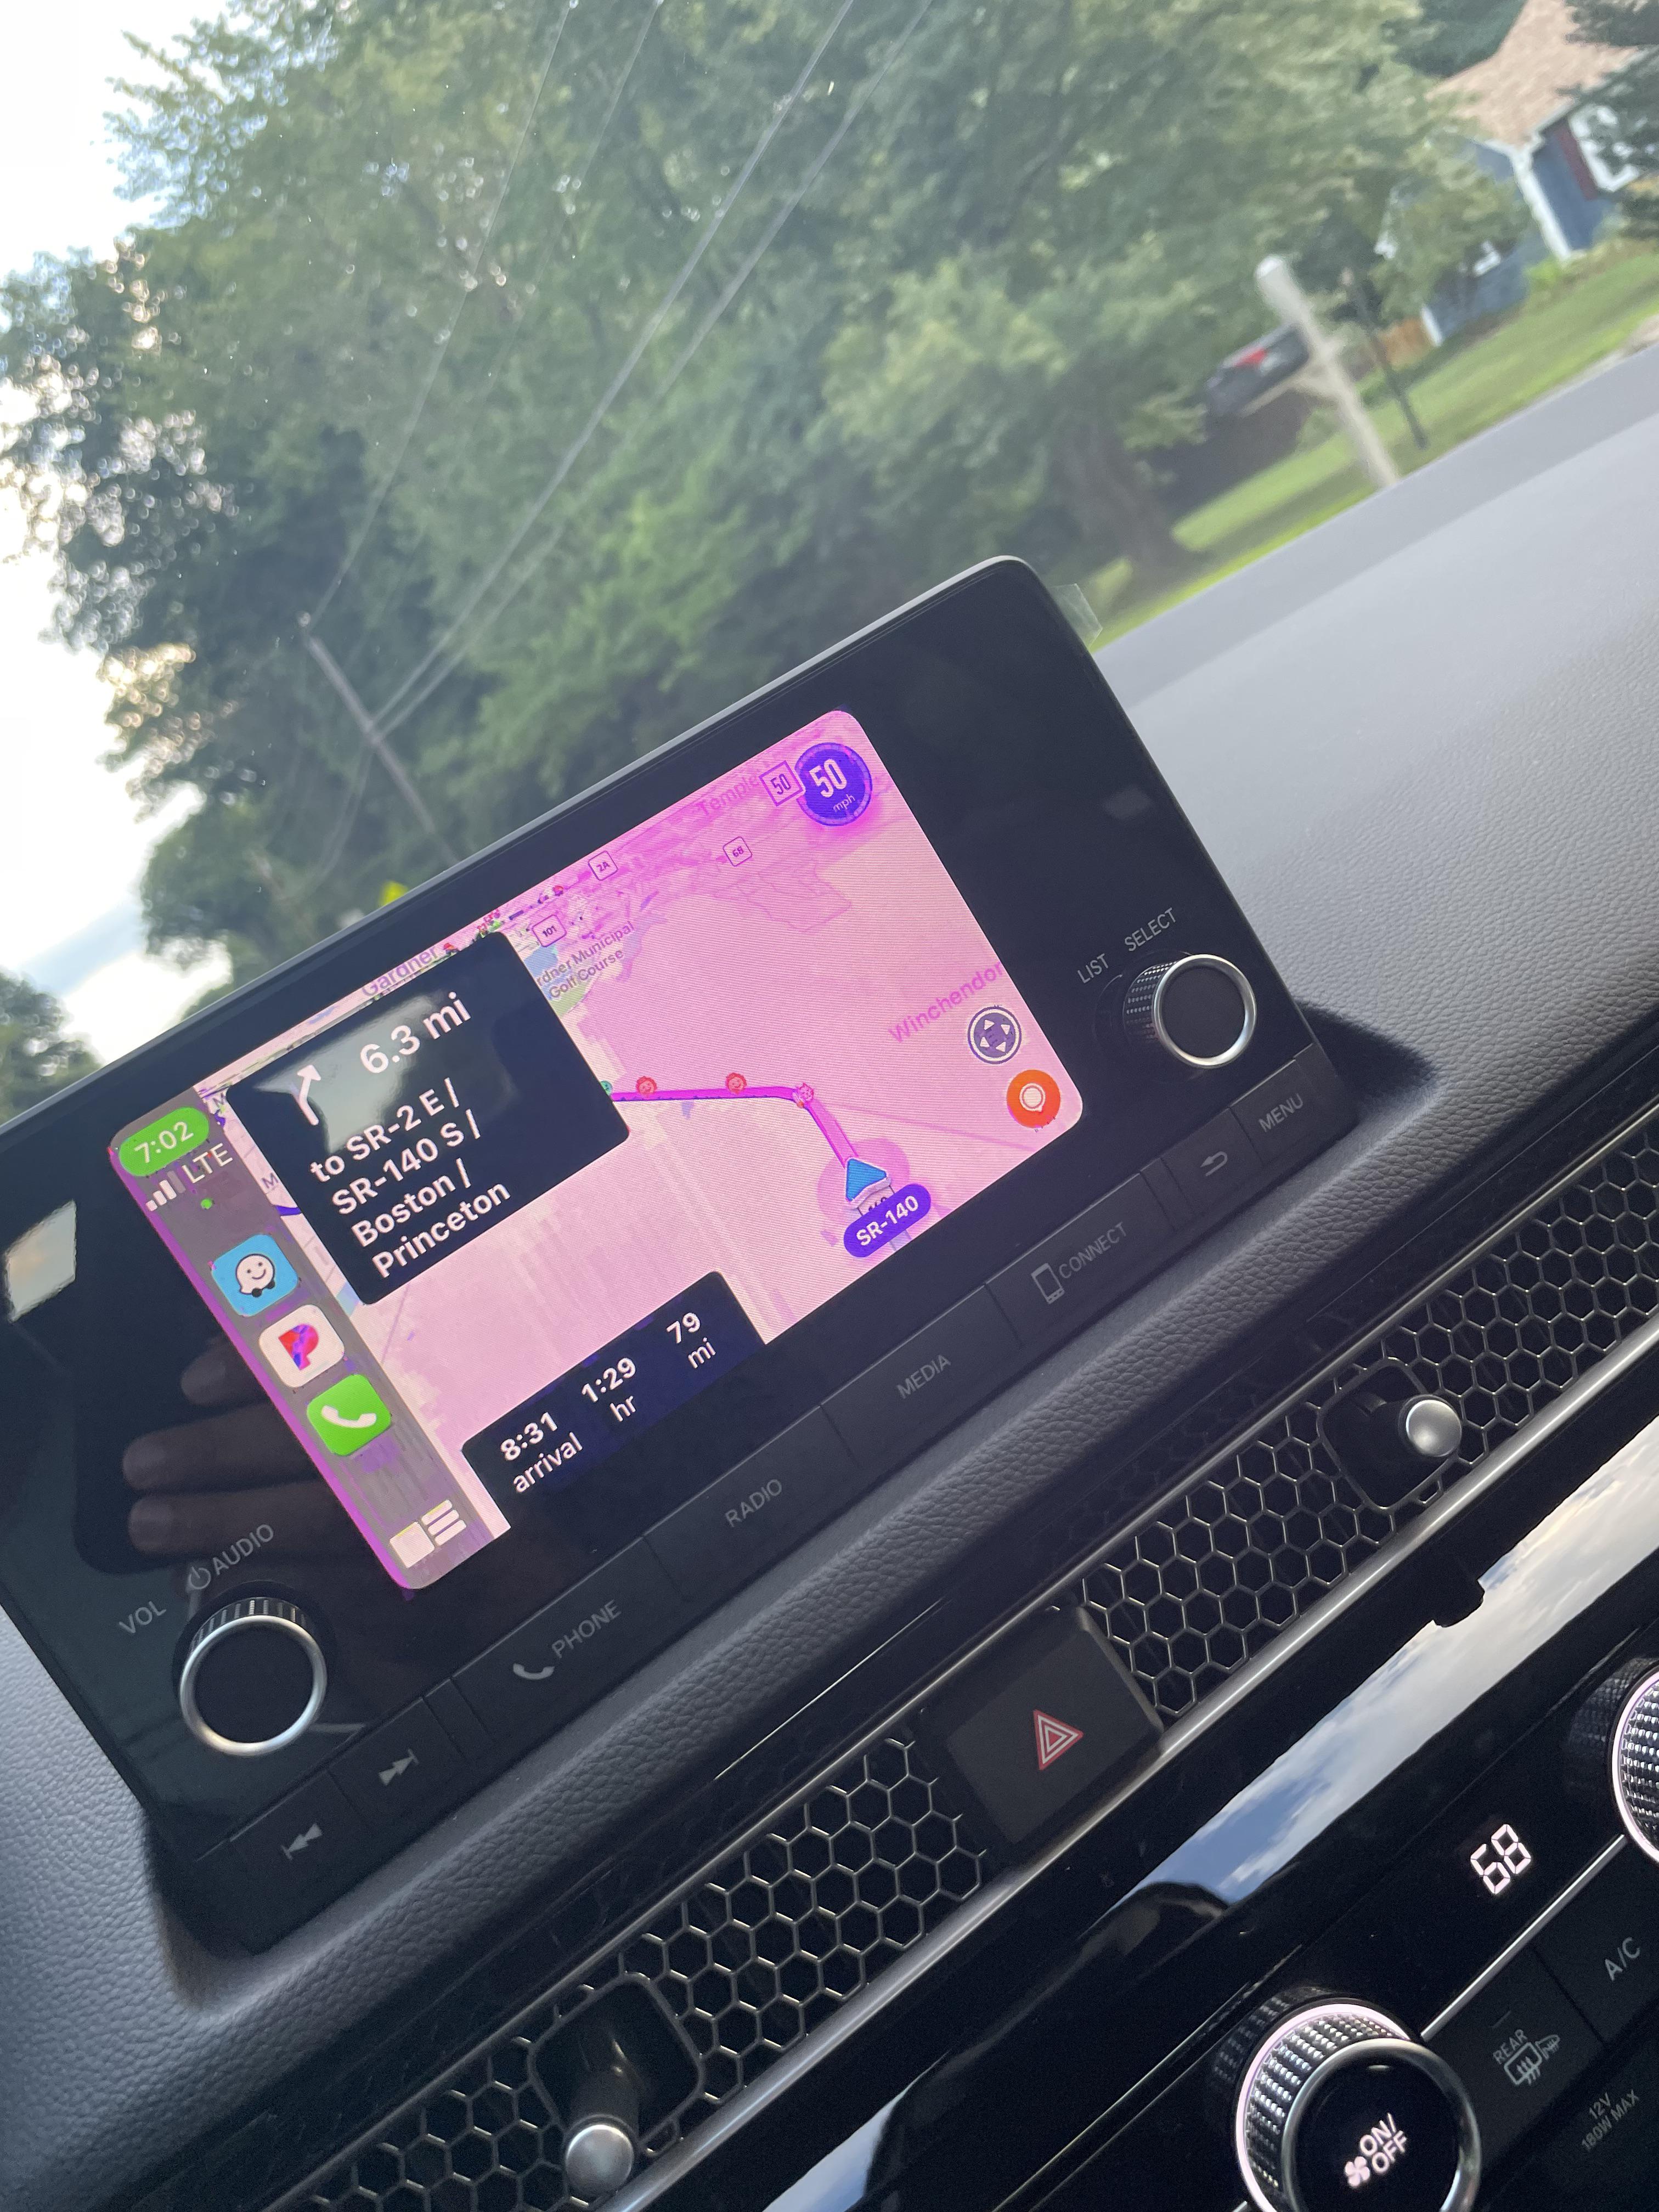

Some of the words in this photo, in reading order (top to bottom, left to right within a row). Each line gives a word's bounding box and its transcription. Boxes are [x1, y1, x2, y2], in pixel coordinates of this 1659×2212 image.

[770, 774, 792, 795] 50
[809, 758, 848, 798] 50
[832, 794, 856, 815] mph
[542, 925, 557, 938] 101
[1124, 907, 1178, 953] SELECT
[362, 946, 438, 997] Gardner
[536, 959, 572, 986] rdner
[571, 921, 635, 965] Municipal
[549, 975, 577, 998] Golf
[577, 950, 624, 981] Course
[1076, 952, 1111, 985] LIST
[359, 1024, 421, 1076] 6.3
[423, 991, 472, 1040] mi
[311, 1155, 345, 1183] to
[347, 1108, 421, 1161] SR-2
[419, 1088, 445, 1117] E
[443, 1077, 461, 1108] /
[1258, 1093, 1304, 1133] MENU
[134, 1121, 194, 1164] 7:02
[182, 1142, 233, 1184] LTE
[332, 1136, 439, 1217] SR-140
[439, 1121, 465, 1148] S
[465, 1109, 482, 1140] /
[351, 1173, 455, 1248] Boston
[458, 1157, 472, 1189] /
[856, 1195, 919, 1246] SR-140
[371, 1182, 511, 1279] Princeton
[1059, 1221, 1128, 1279] CONNECT
[665, 1312, 701, 1344] 79
[687, 1337, 716, 1369] mi
[581, 1357, 636, 1403] 1:29
[895, 1353, 952, 1400] MEDIA
[610, 1395, 637, 1423] hr
[499, 1411, 558, 1462] 8:31
[512, 1431, 583, 1493] arrival
[725, 1478, 783, 1528] RADIO
[210, 1522, 275, 1576] AUDIO
[119, 1600, 166, 1637] VOL
[550, 1599, 622, 1660] PHONE
[1469, 1823, 1532, 1895] 68
[1603, 1936, 1643, 1982] A/C
[1492, 2028, 1528, 2066] REAR
[1589, 2091, 1611, 2120] 12V
[1611, 2089, 1640, 2121] MAX
[1359, 2113, 1398, 2157] ON/
[1371, 2131, 1408, 2174] OFF
